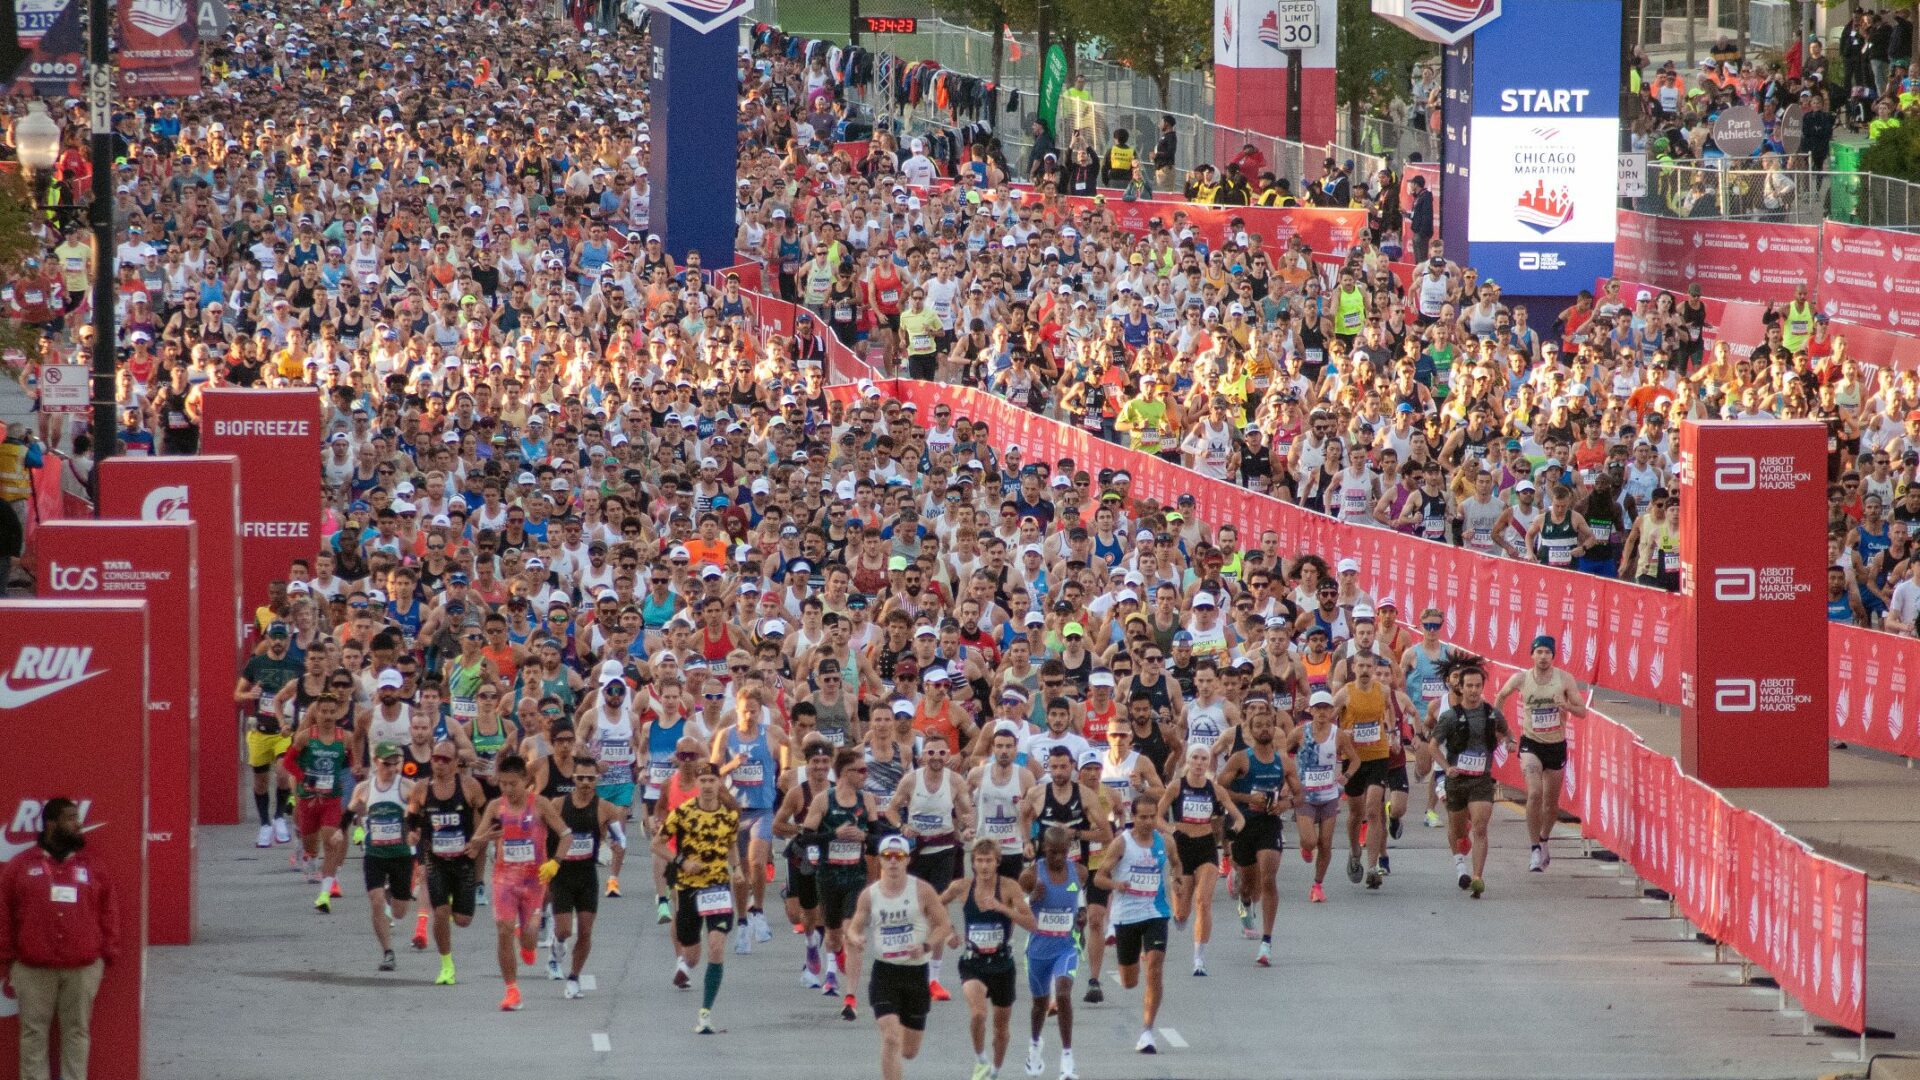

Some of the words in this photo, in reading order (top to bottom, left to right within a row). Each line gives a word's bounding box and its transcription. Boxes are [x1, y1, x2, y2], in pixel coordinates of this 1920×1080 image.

[1282, 4, 1314, 12] SPEED
[198, 2, 217, 27] A
[1285, 14, 1310, 22] LIMIT
[1284, 25, 1312, 42] 30
[1501, 89, 1589, 112] START
[1728, 120, 1751, 129] Para
[1717, 129, 1762, 140] Athletics
[1515, 152, 1576, 164] CHICAGO
[1514, 166, 1576, 174] MARATHON
[1618, 171, 1638, 179] URN
[1760, 456, 1795, 465] ABBOTT
[1760, 465, 1793, 473] WORLD
[1760, 473, 1811, 481] MARATHON
[1760, 481, 1796, 490] MAJORS
[242, 522, 309, 538] FREEZE
[103, 561, 132, 569] TATA
[50, 561, 98, 591] tcs
[103, 571, 170, 581] CONSULTANCY
[1760, 567, 1795, 576] ABBOTT
[1760, 576, 1793, 584] WORLD
[103, 582, 146, 591] SERVICES
[1760, 584, 1811, 592] MARATHON
[1760, 592, 1796, 601] MAJORS
[12, 646, 93, 680] RUN
[1760, 678, 1795, 687] ABBOTT
[1760, 686, 1793, 695] WORLD
[1760, 694, 1811, 703] MARATHON
[1760, 703, 1796, 712] MAJORS
